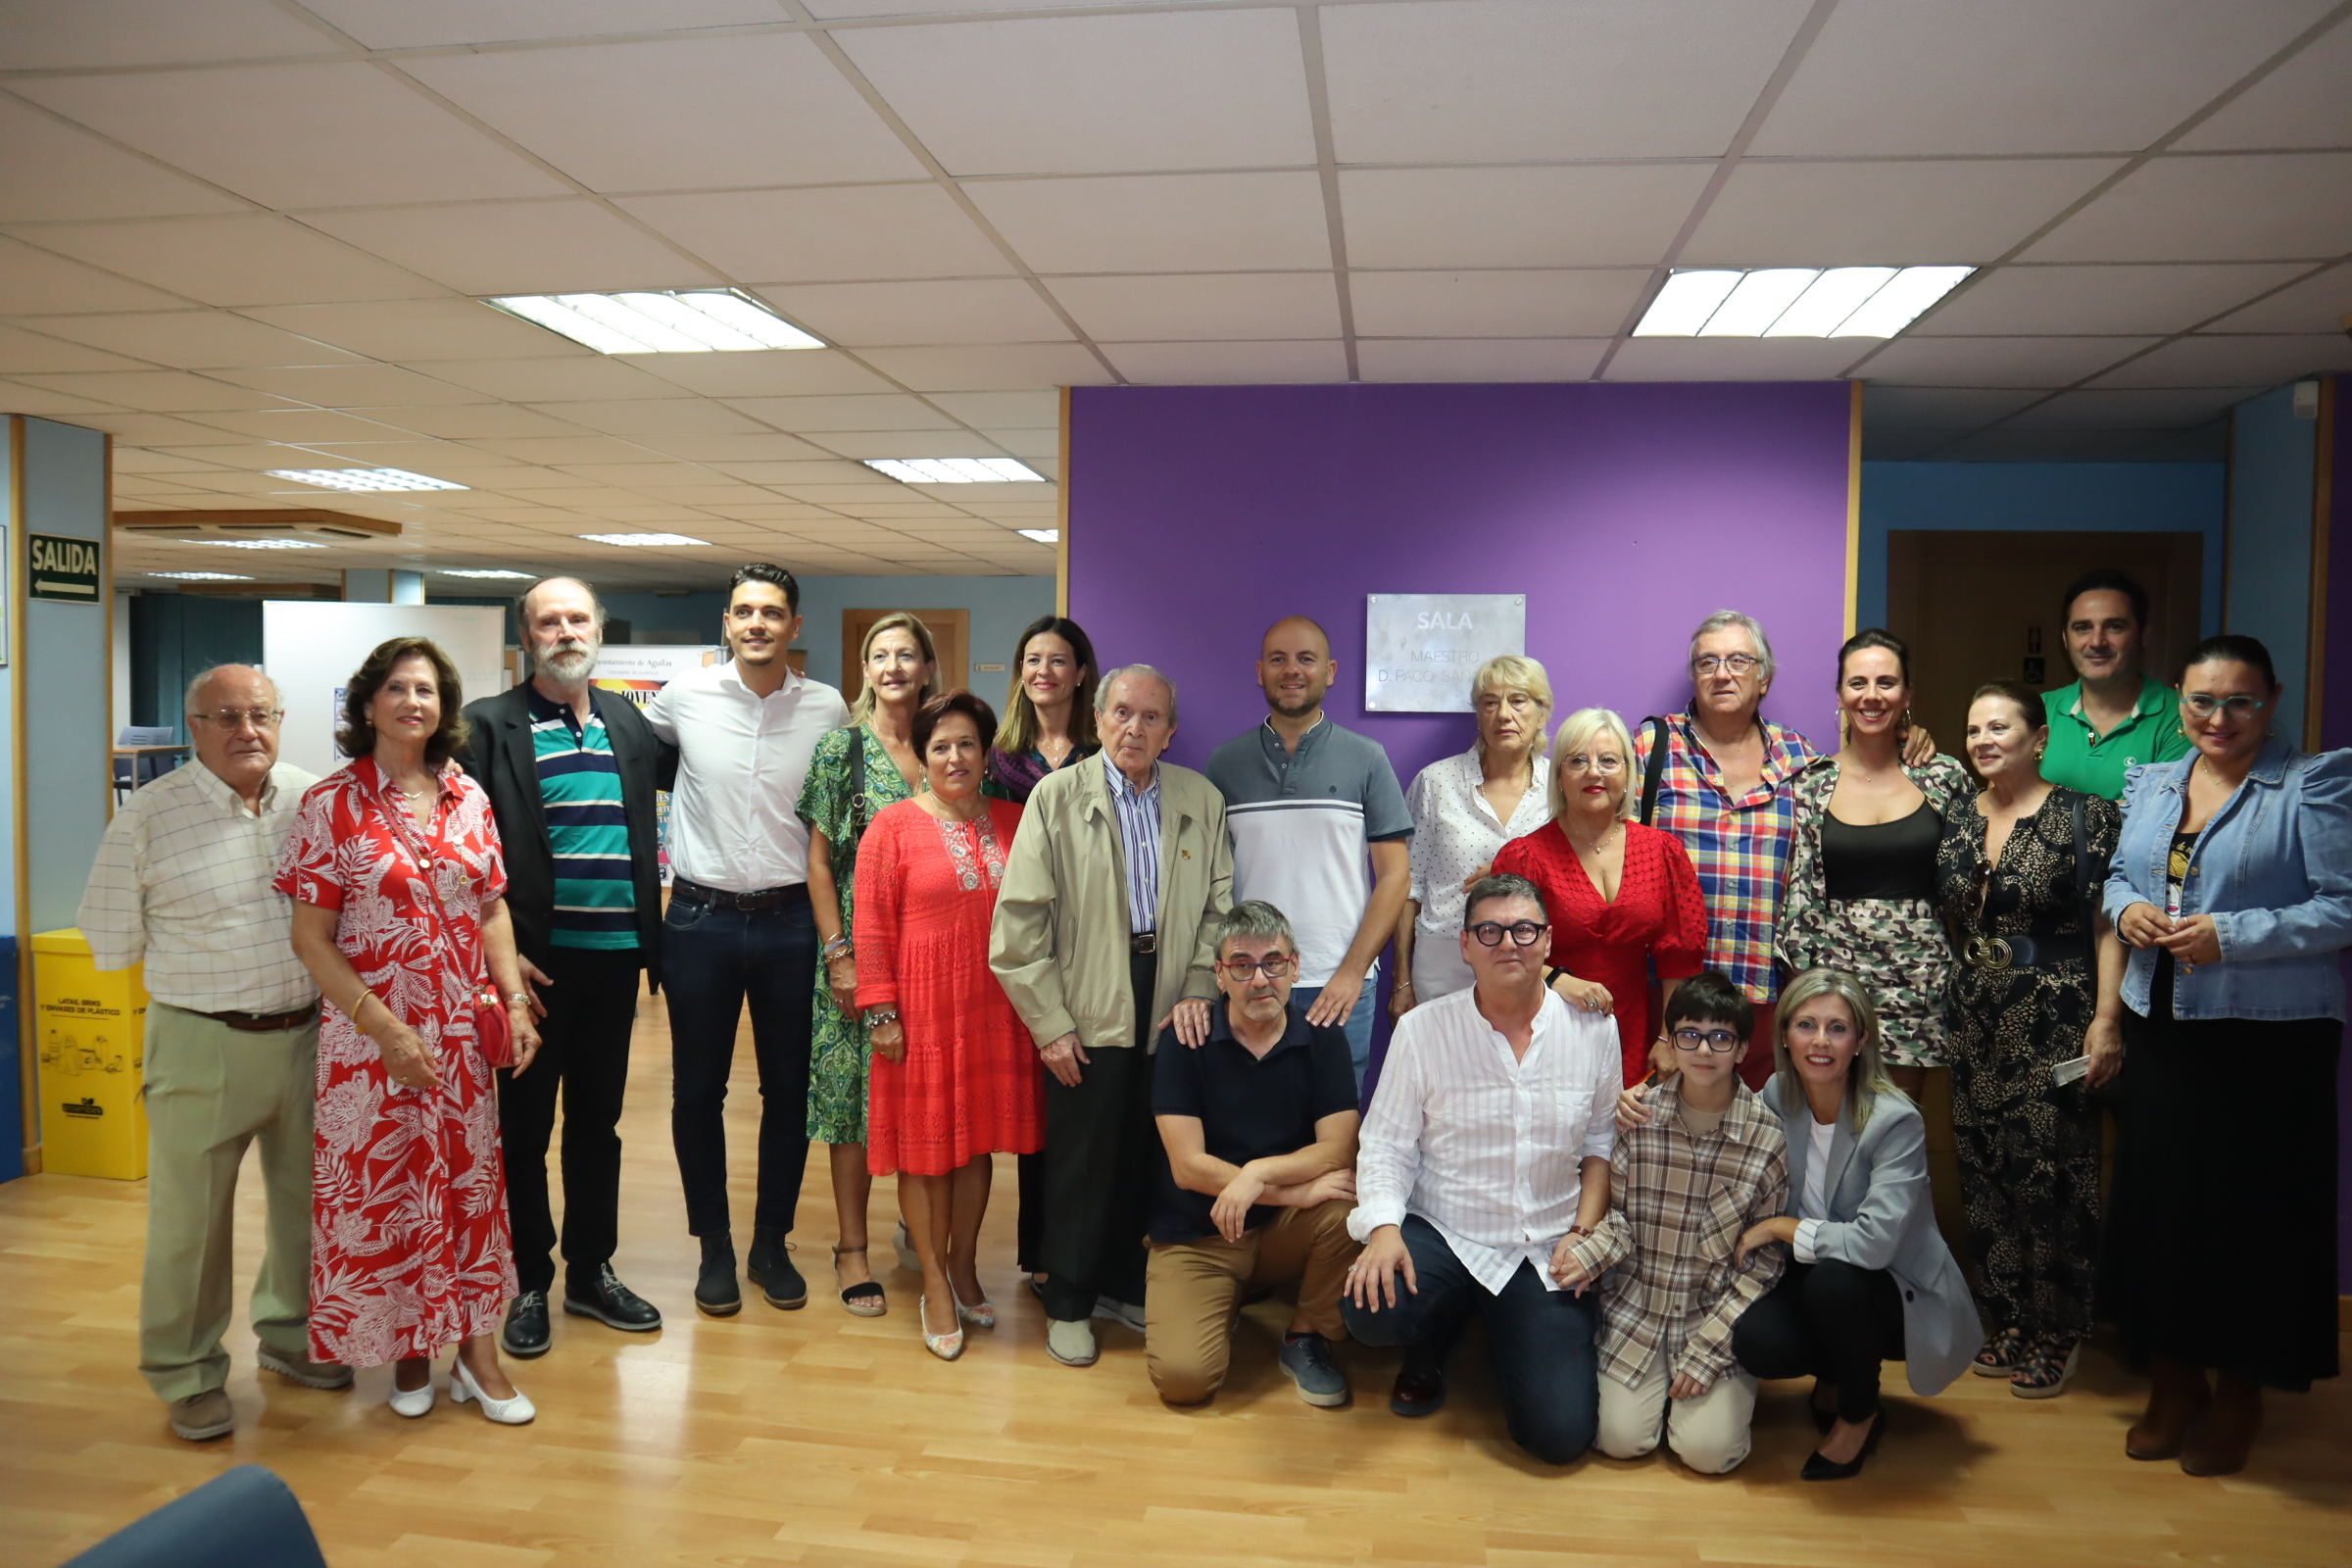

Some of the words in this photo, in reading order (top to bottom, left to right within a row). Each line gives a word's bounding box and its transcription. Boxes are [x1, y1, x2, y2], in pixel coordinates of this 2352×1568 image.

[32, 539, 96, 575] SALIDA
[1417, 612, 1473, 629] SALA
[597, 659, 636, 667] yuntamiento
[1410, 650, 1480, 663] MAESTRO
[1378, 669, 1392, 682] D.
[1396, 669, 1434, 682] PACO
[46, 1004, 75, 1013] ENVASES
[87, 1006, 121, 1016] PLÁSTICO
